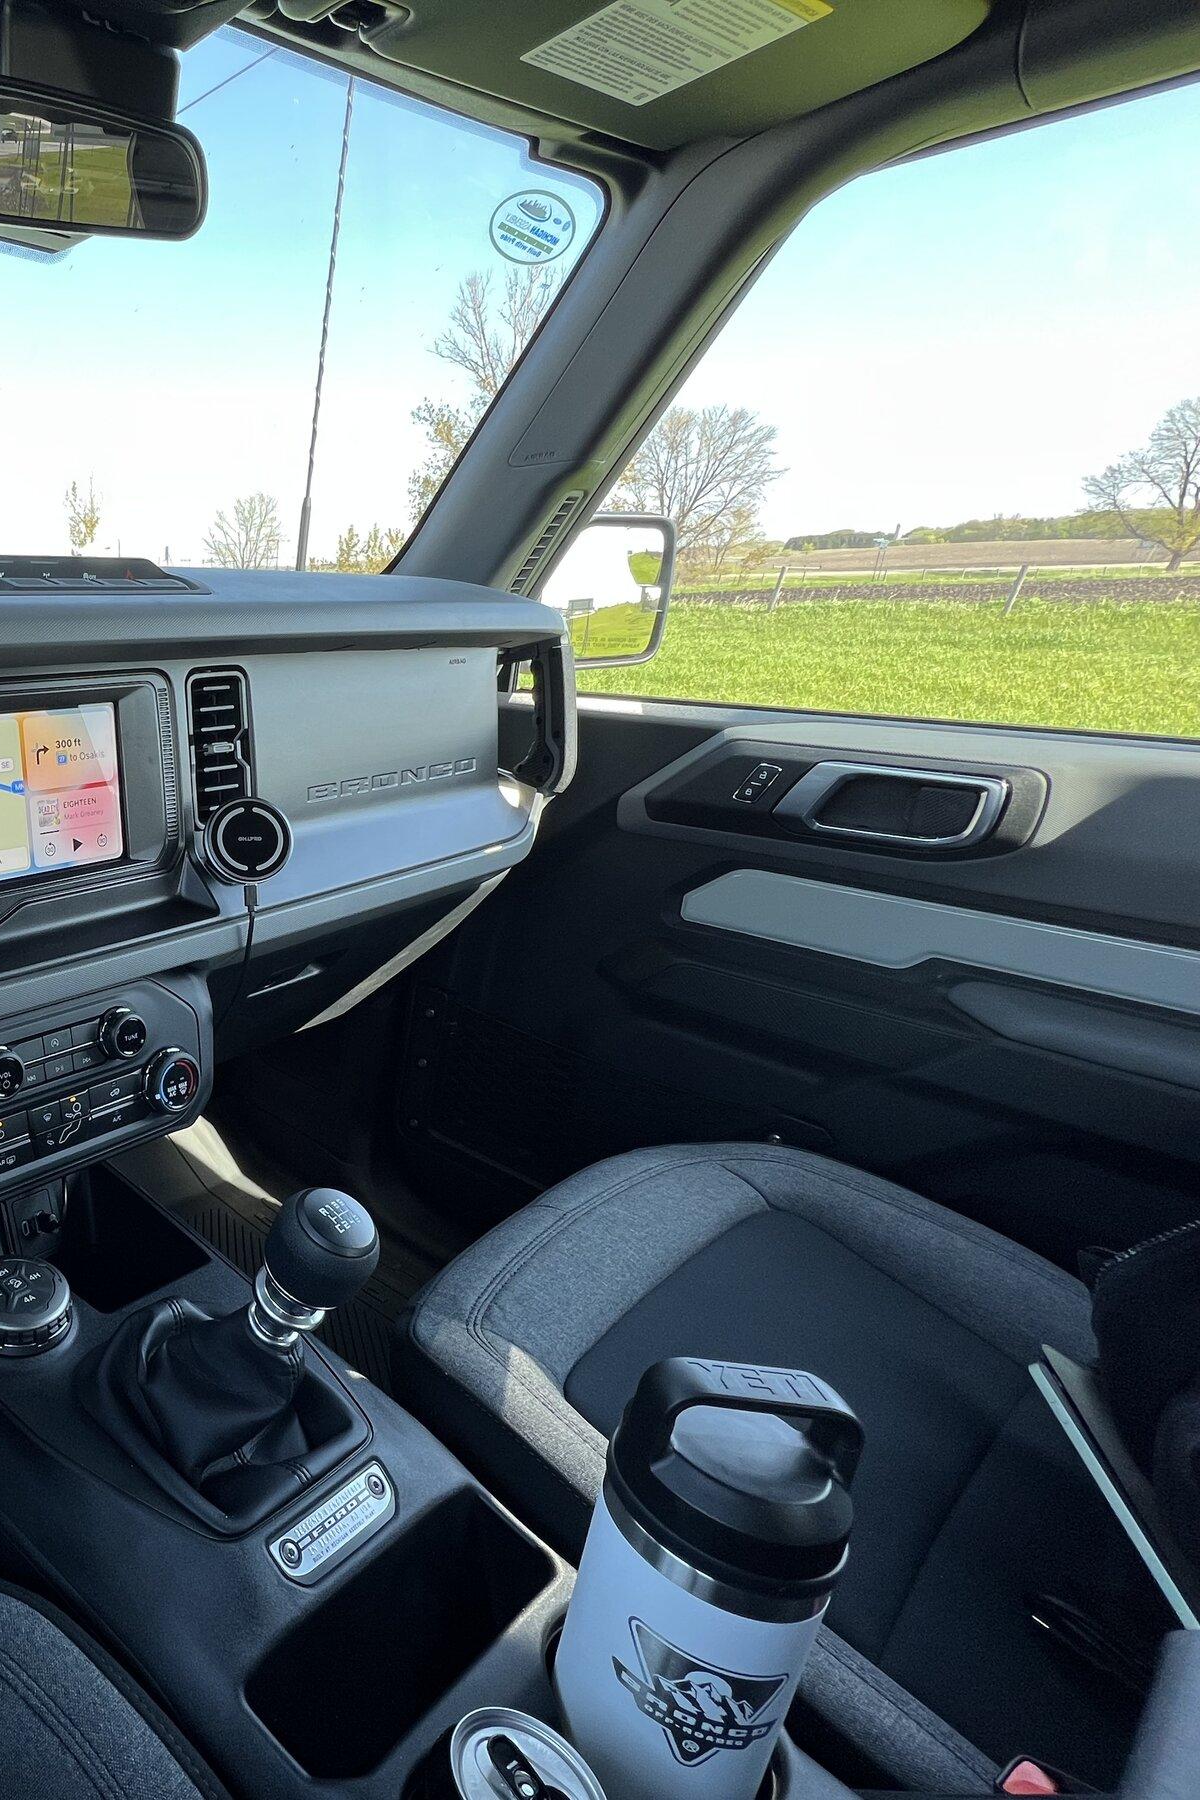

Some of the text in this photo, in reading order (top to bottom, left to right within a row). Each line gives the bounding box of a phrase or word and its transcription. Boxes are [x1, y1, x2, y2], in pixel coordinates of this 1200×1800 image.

[55, 738, 81, 748] 300 ft
[70, 753, 78, 761] to
[307, 757, 476, 803] BRONCO
[63, 797, 97, 809] EIGHTEEN
[125, 1032, 138, 1041] TUNE
[30, 1272, 42, 1280] 4H
[24, 1294, 36, 1303] 4A
[687, 1361, 828, 1401] YETI
[311, 1498, 358, 1538] FORD
[620, 1670, 769, 1738] BRONCO
[644, 1703, 744, 1746] OFF-ROADER
